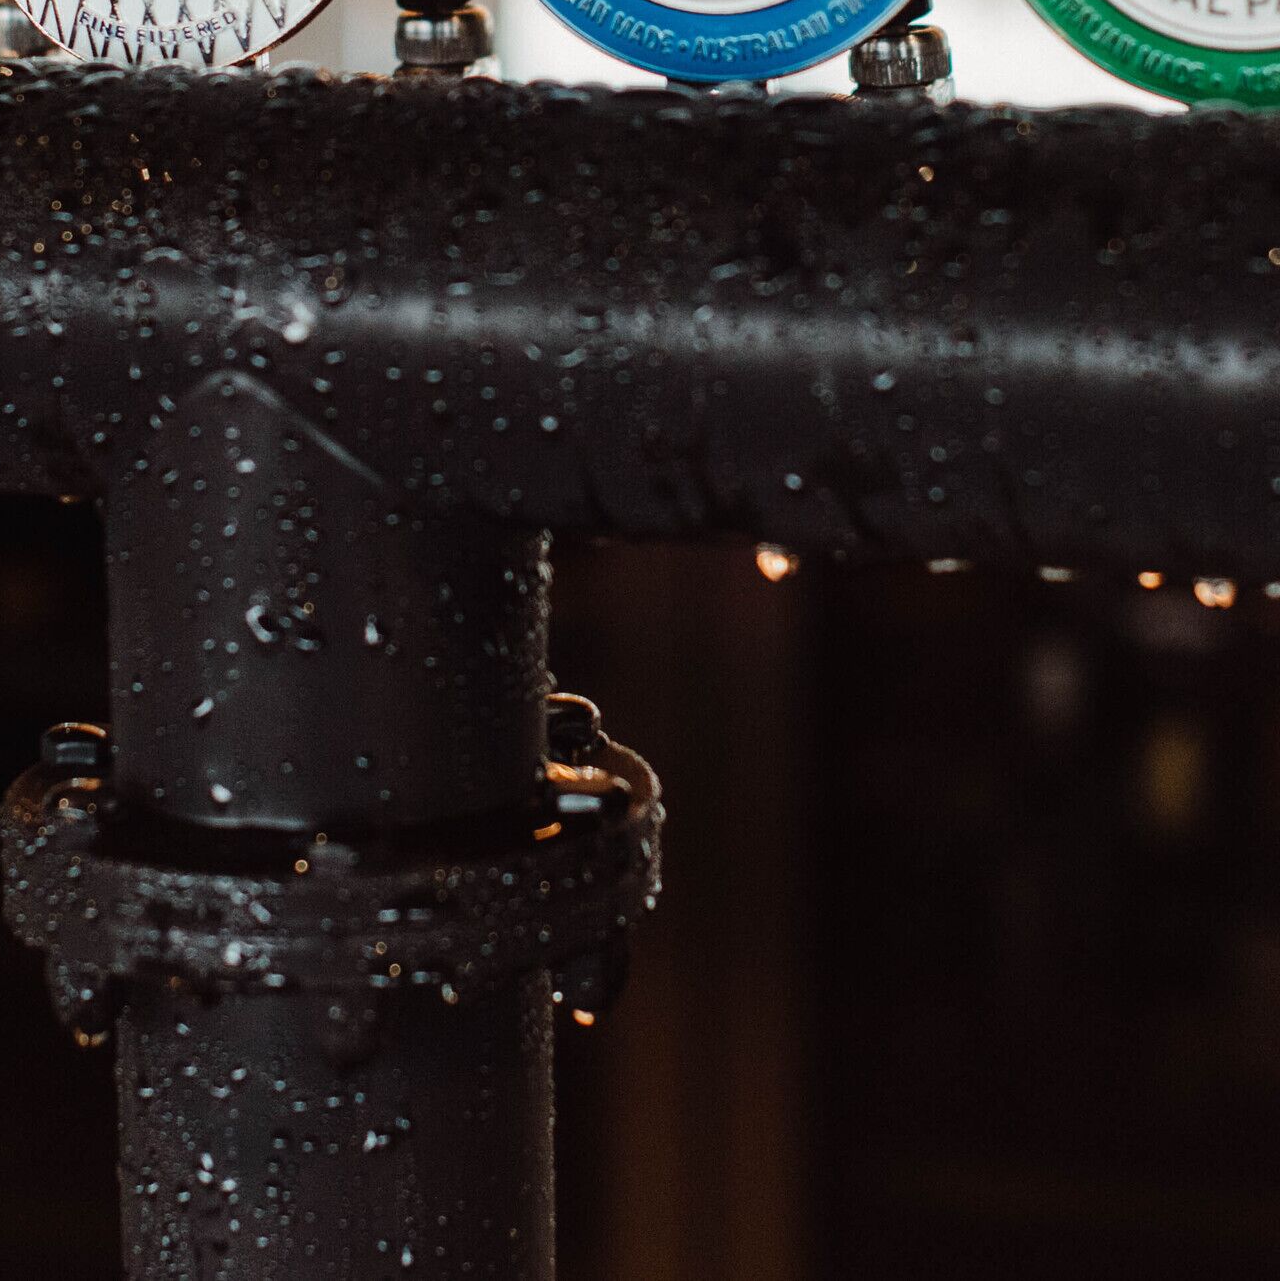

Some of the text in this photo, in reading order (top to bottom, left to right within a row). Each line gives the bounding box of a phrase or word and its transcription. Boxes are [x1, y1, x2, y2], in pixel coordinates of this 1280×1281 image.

[79, 11, 238, 44] FINE FILTERED
[609, 11, 675, 55] MADE
[691, 11, 828, 63] AUSTRALIAN
